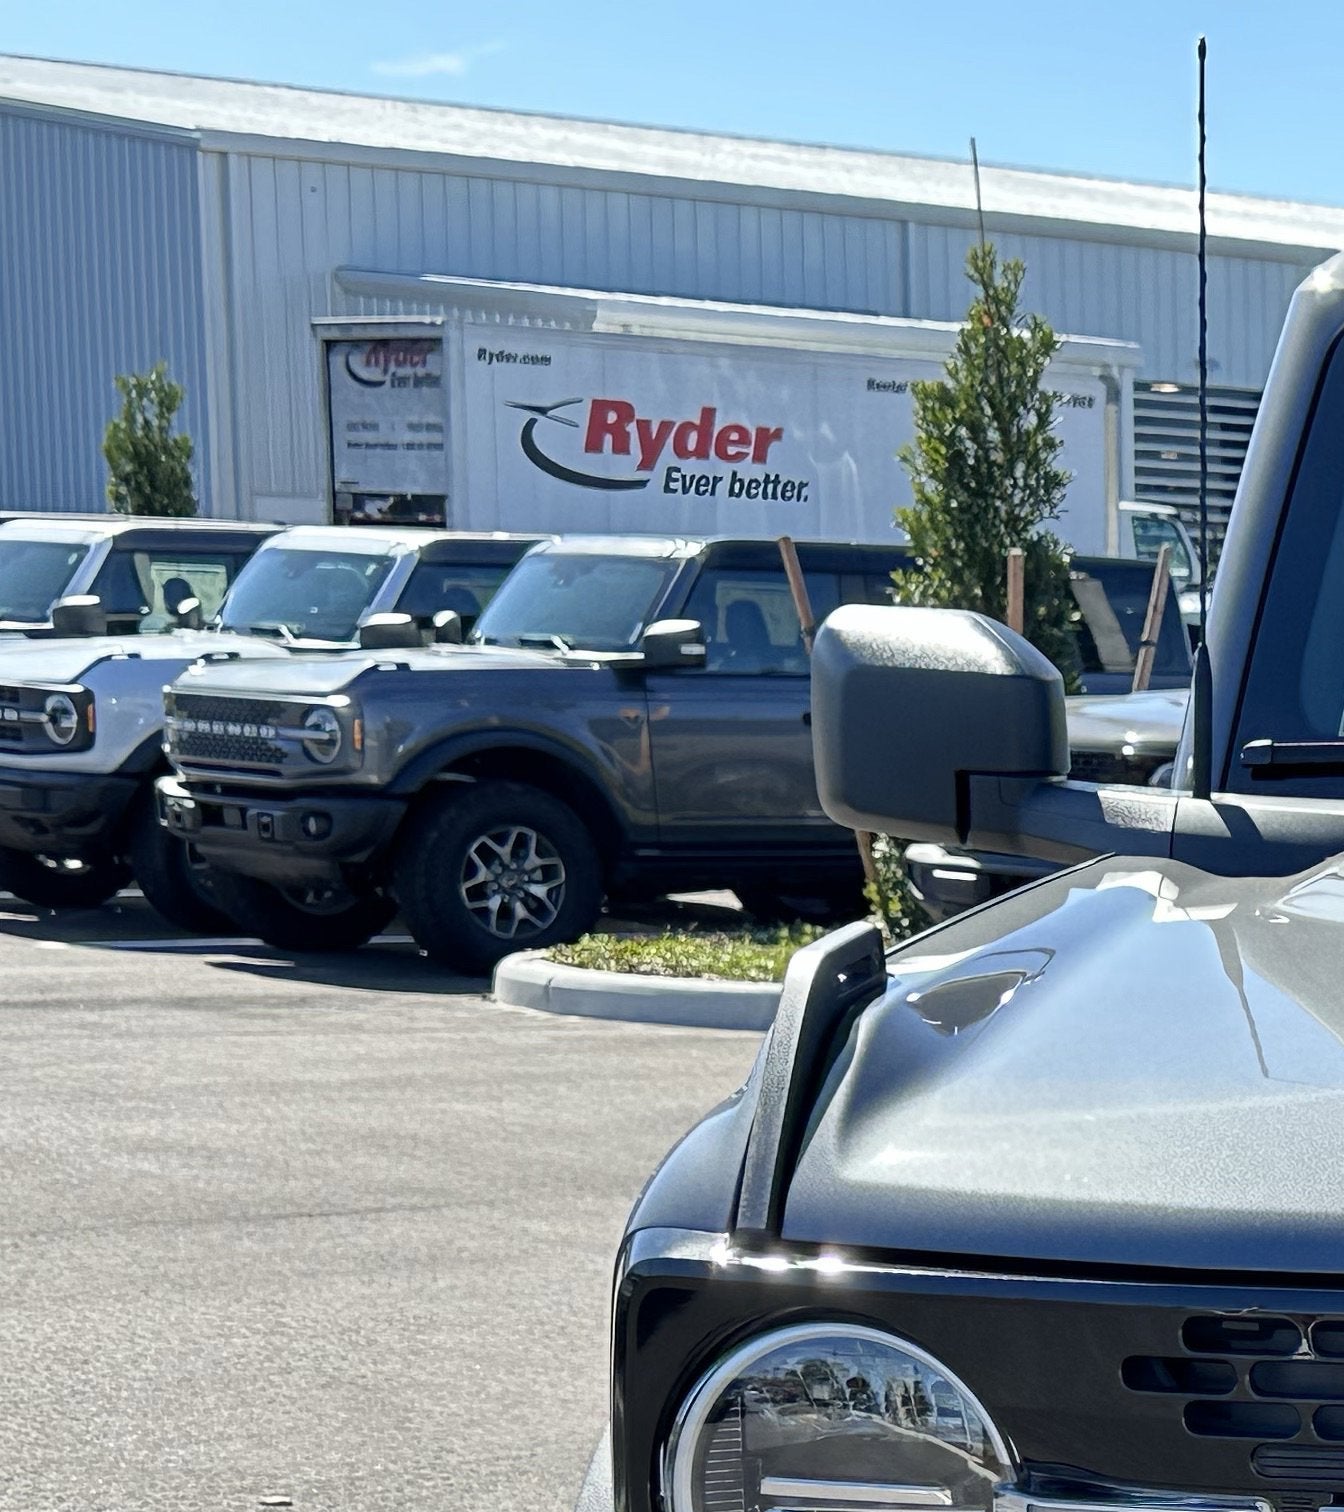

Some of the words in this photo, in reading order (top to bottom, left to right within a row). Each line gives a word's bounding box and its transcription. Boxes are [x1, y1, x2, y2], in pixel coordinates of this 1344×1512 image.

[585, 398, 784, 472] Ryder
[663, 466, 723, 497] Ever
[728, 470, 808, 502] better.
